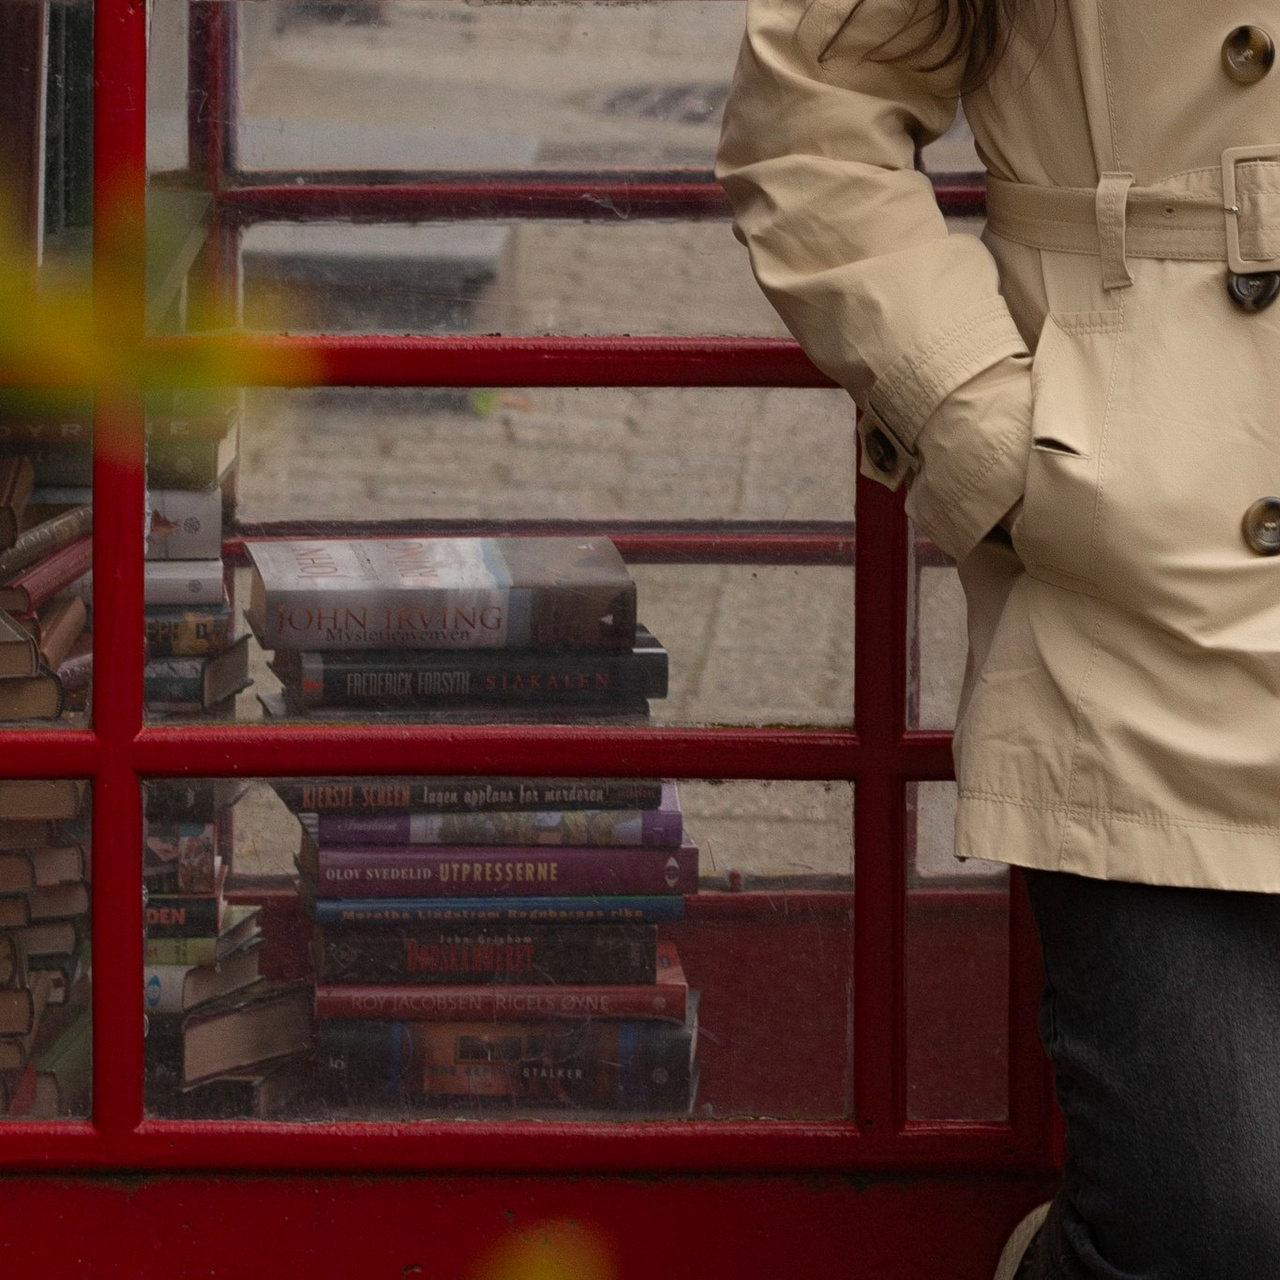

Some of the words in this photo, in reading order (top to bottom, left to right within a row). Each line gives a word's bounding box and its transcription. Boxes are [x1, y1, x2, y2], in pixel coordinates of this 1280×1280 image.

[277, 604, 368, 635] JOHN
[385, 605, 503, 631] IRVING
[346, 671, 413, 696] FREDERICK
[417, 670, 471, 695] FORSYTH
[485, 671, 610, 690] SJAKALEN
[423, 785, 458, 805] Ingen
[325, 868, 362, 881] OLOV
[365, 867, 432, 881] SVEDELID
[439, 862, 558, 882] UTPRESSERNE
[352, 995, 387, 1011] ROY
[391, 995, 482, 1013] JACOBSEN
[496, 995, 555, 1011] RIGELS
[561, 994, 611, 1013] ØYNE
[523, 1067, 583, 1080] STALKER
